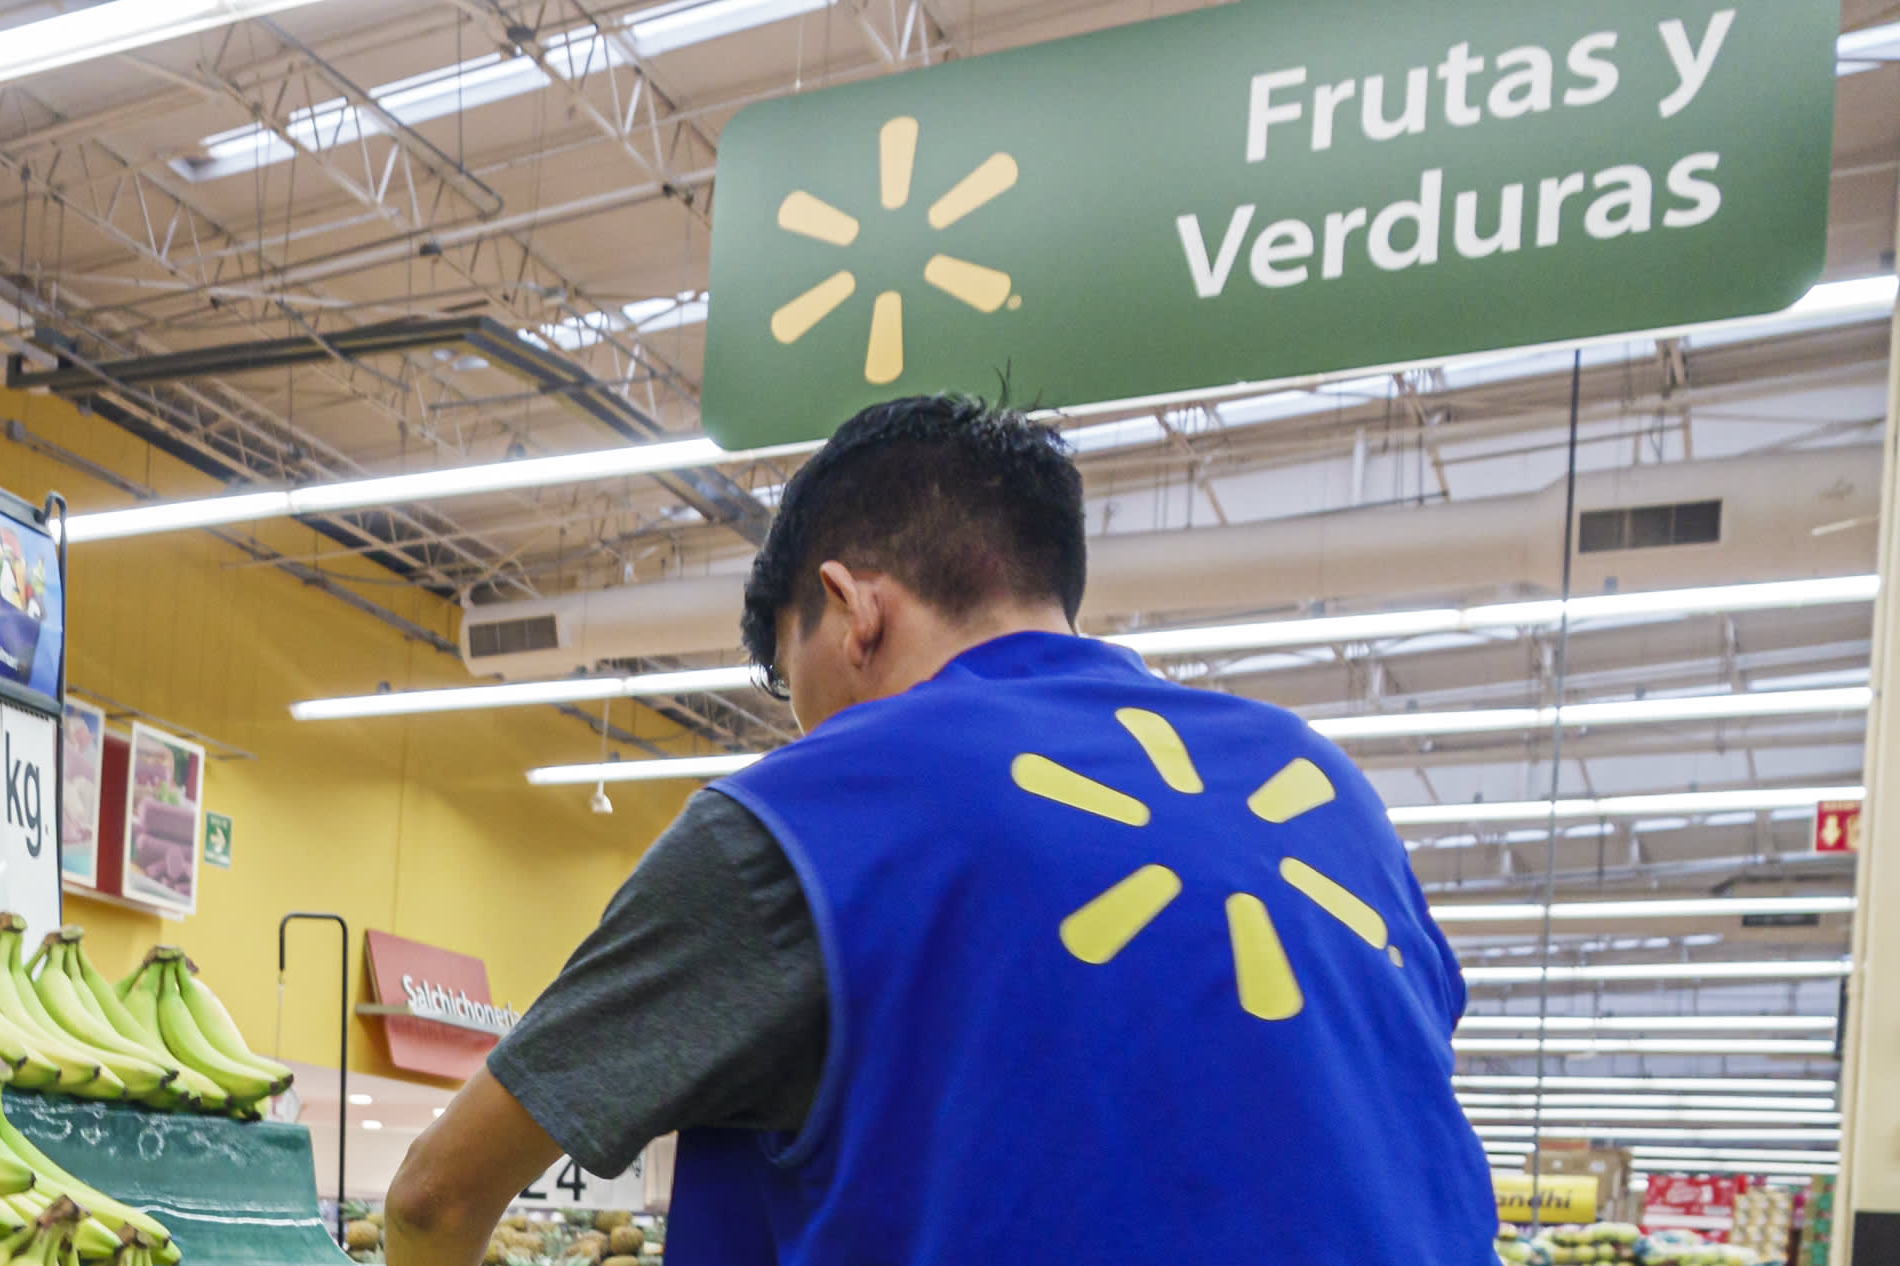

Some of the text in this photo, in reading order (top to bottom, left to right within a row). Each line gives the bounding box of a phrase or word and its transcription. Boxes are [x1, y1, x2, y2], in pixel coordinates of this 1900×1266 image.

[1244, 8, 1737, 163] Frutas y
[1175, 151, 1722, 299] Verduras
